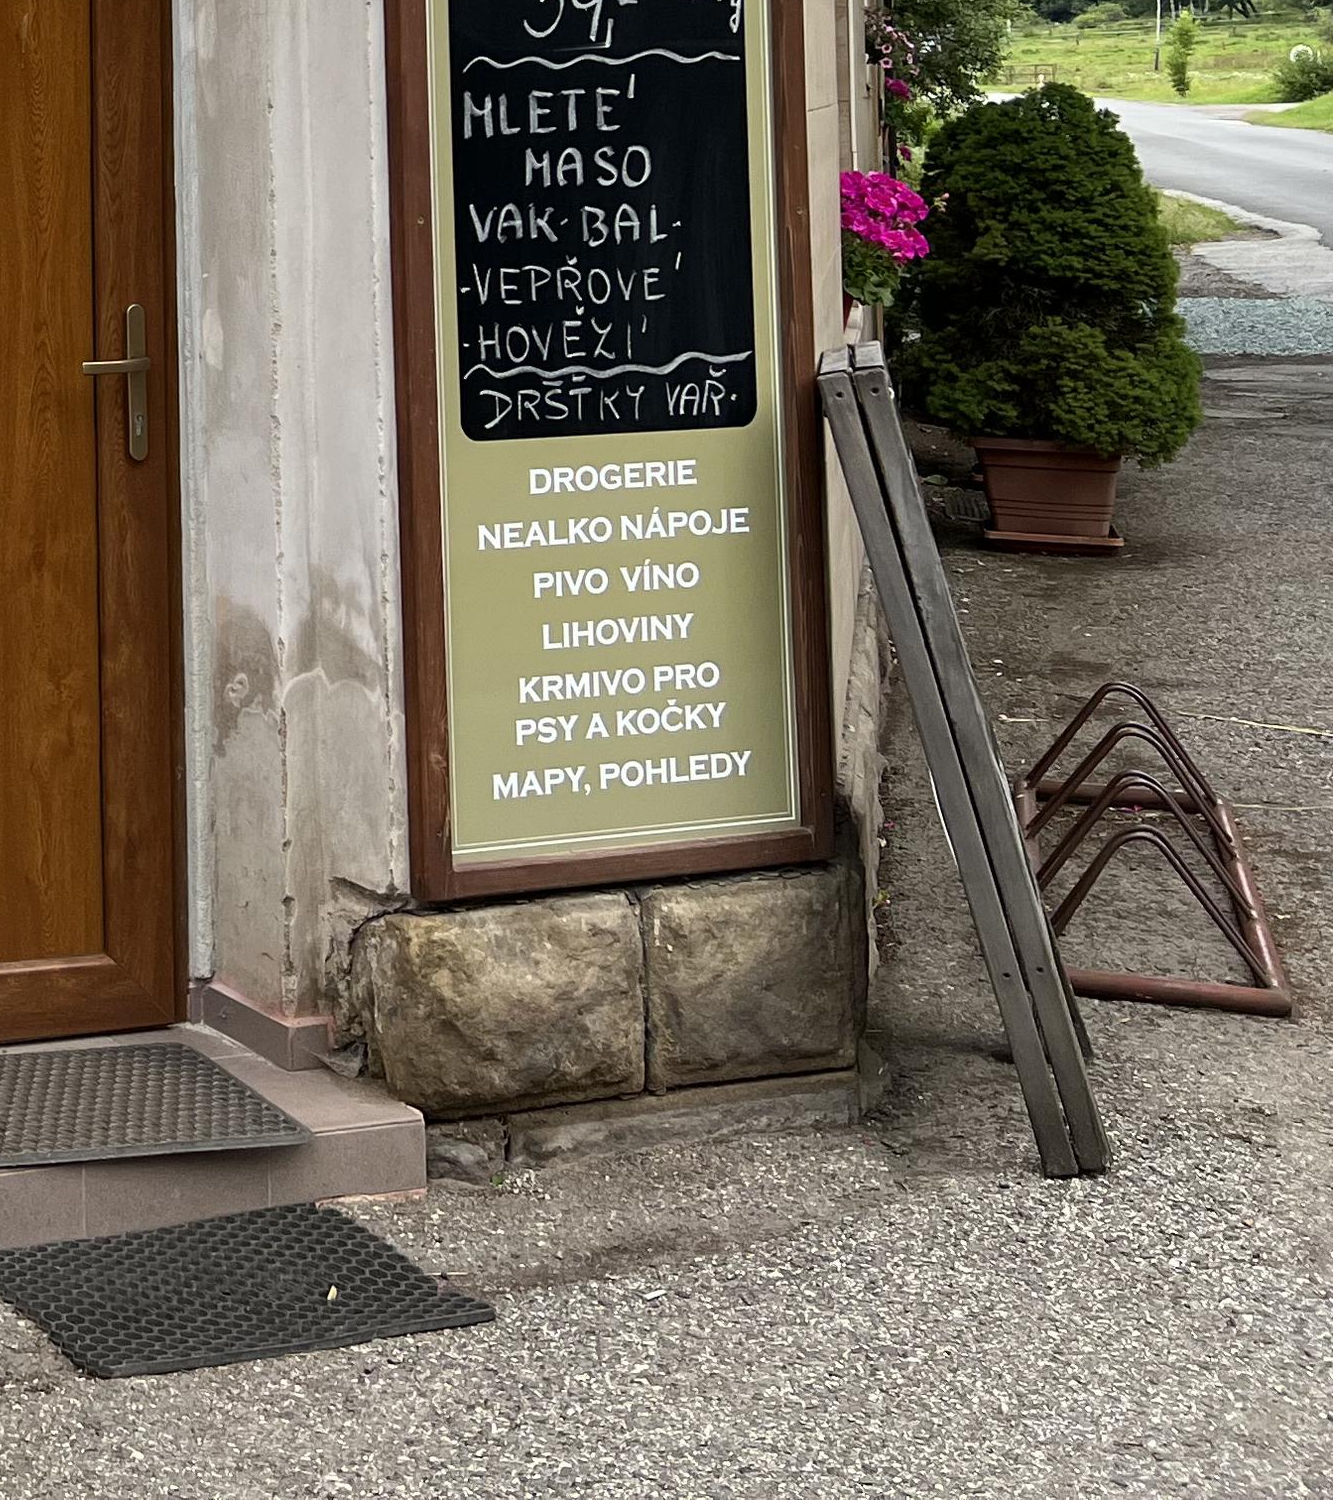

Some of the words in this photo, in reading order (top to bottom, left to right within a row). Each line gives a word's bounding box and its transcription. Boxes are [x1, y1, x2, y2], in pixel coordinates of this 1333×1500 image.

[524, 144, 652, 188] MASO
[528, 459, 698, 495] DROGERIE
[477, 516, 613, 551] NEALKO
[620, 506, 750, 540] NÁPOJE
[533, 568, 609, 598] PIVO
[619, 558, 700, 591] VÍNO
[542, 612, 694, 650] LIHOVINY
[518, 668, 645, 703] KRMIVO
[653, 661, 721, 692] PRO
[515, 714, 577, 746] PSY
[585, 713, 610, 740] A
[616, 699, 727, 736] KOČKY
[492, 765, 592, 801] MAPY,
[599, 750, 753, 791] POHLEDY
